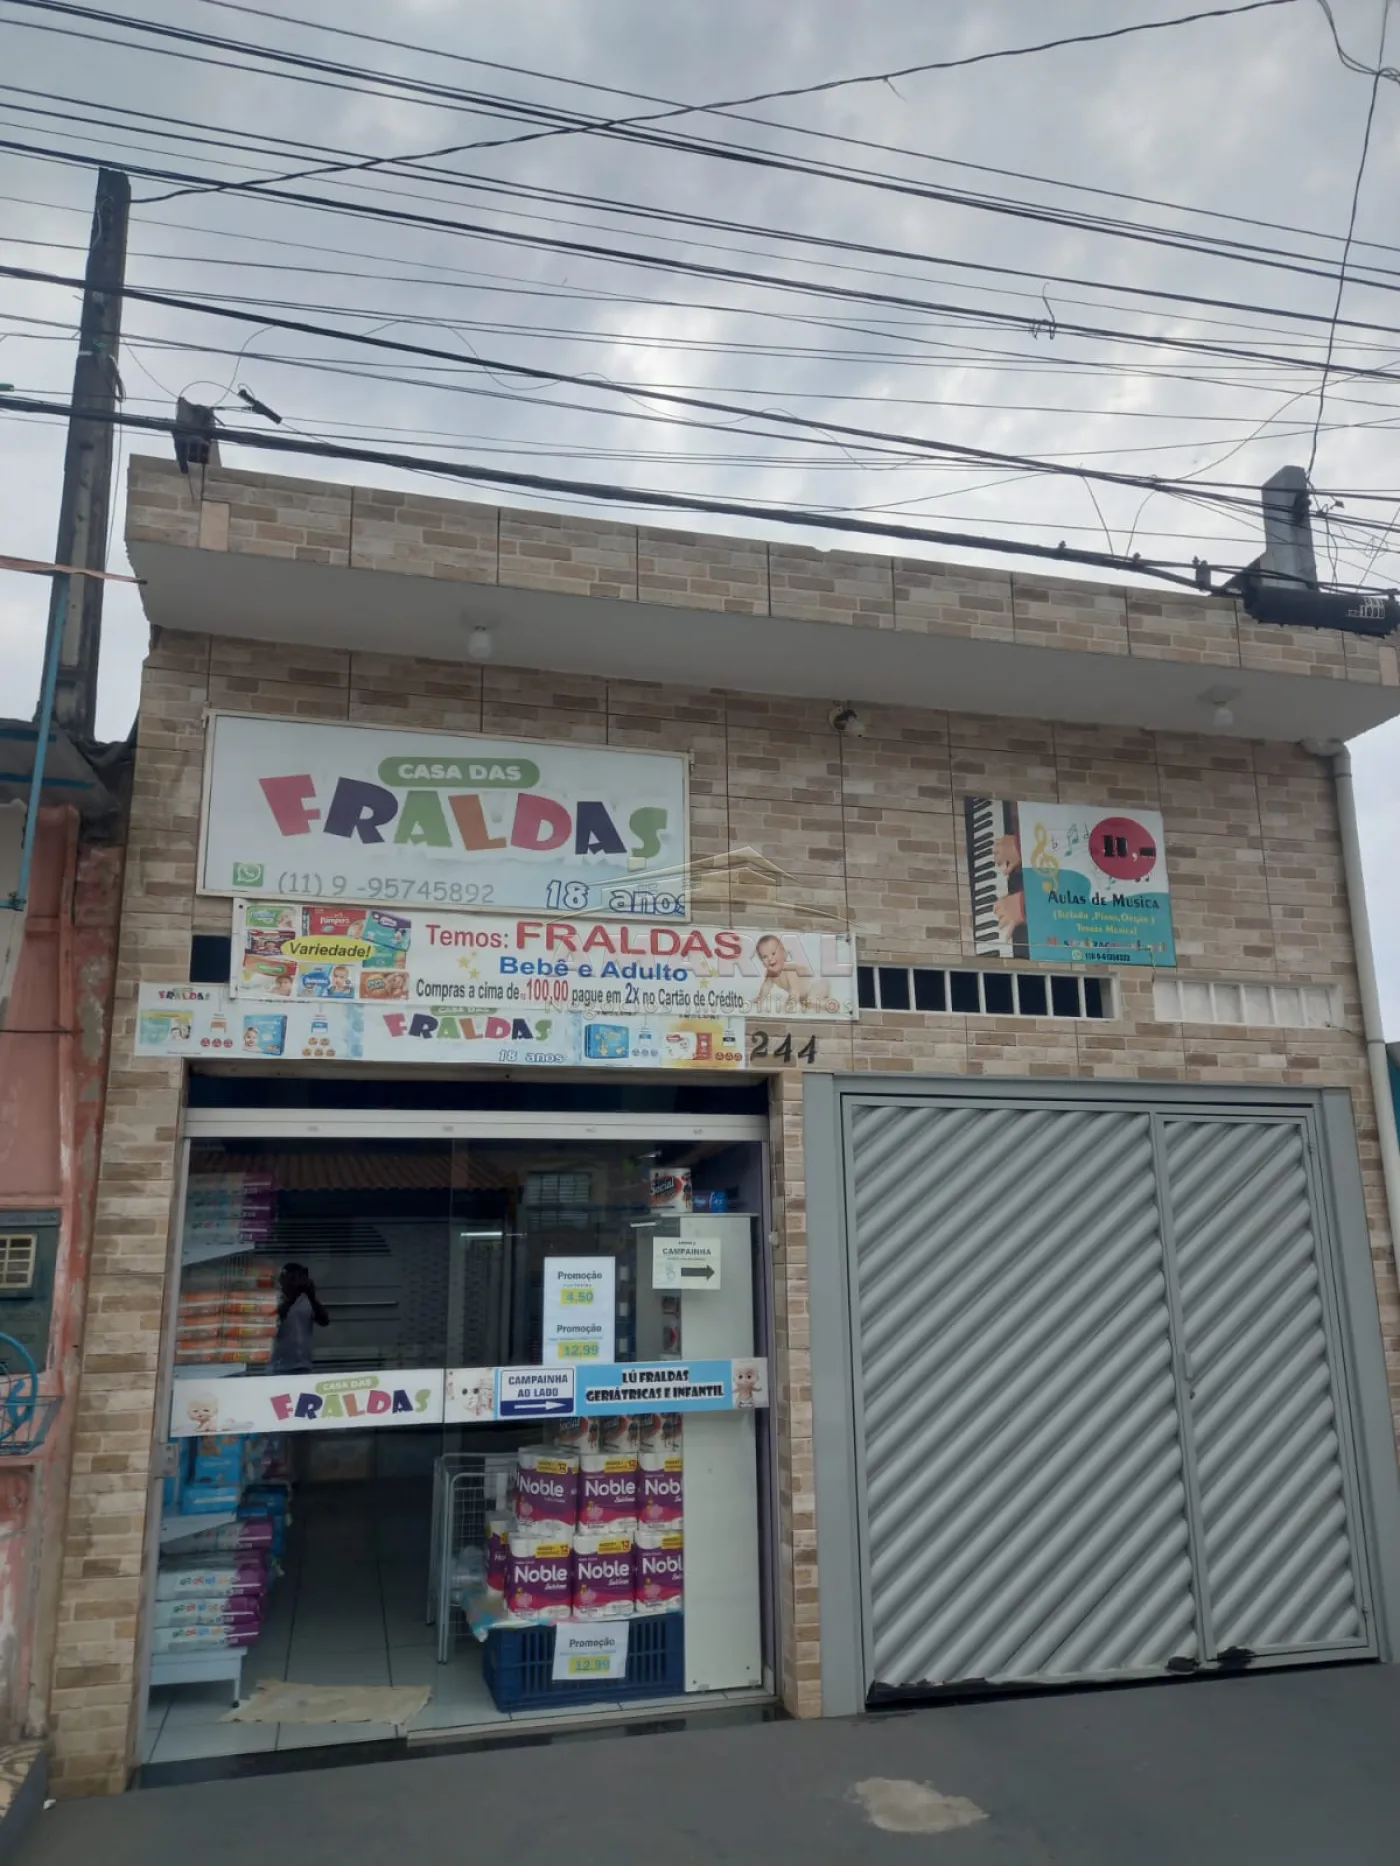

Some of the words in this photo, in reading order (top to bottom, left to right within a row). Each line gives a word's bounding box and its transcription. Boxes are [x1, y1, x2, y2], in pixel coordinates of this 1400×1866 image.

[398, 763, 461, 781] CASA
[469, 764, 521, 782] DAS
[258, 773, 668, 860] FRALDAS
[278, 871, 322, 896] (11)
[331, 876, 348, 896] 9
[546, 879, 590, 910] 18
[1091, 892, 1107, 906] de
[289, 941, 371, 958] Variedade!
[426, 924, 509, 949] Temos:
[516, 921, 741, 960] FRALDAS
[500, 956, 568, 978] Bebê
[578, 964, 592, 977] e
[601, 961, 688, 982] Adulto
[416, 977, 465, 1000] Compras
[468, 984, 475, 998] a
[478, 981, 504, 1000] cima
[506, 983, 519, 1000] de
[572, 988, 603, 1006] pague
[606, 990, 621, 1001] em
[643, 989, 655, 1004] no
[658, 986, 689, 1006] Cartão
[692, 990, 706, 1006] de
[708, 989, 744, 1008] Crédito
[382, 1012, 553, 1041] FRALDAS
[499, 1050, 518, 1062] 18
[525, 1052, 566, 1064] anos
[749, 1030, 818, 1065] 244
[557, 1270, 602, 1281] Promoção
[556, 1323, 602, 1334] Promoção
[508, 1374, 568, 1385] CAMPAINHA
[622, 1369, 637, 1383] LÚ
[639, 1370, 689, 1383] FRALDAS
[323, 1382, 349, 1391] CASA
[518, 1388, 531, 1398] AO
[533, 1387, 559, 1397] LADO
[586, 1386, 661, 1402] GERIÁTRICAS
[664, 1388, 671, 1399] E
[672, 1384, 724, 1398] INFANTIL
[270, 1388, 432, 1421] FRALDAS
[519, 1475, 565, 1497] Noble
[584, 1477, 636, 1497] Noble
[514, 1563, 567, 1583] Noble
[578, 1560, 630, 1581] Noble
[569, 1636, 616, 1649] Promoção
